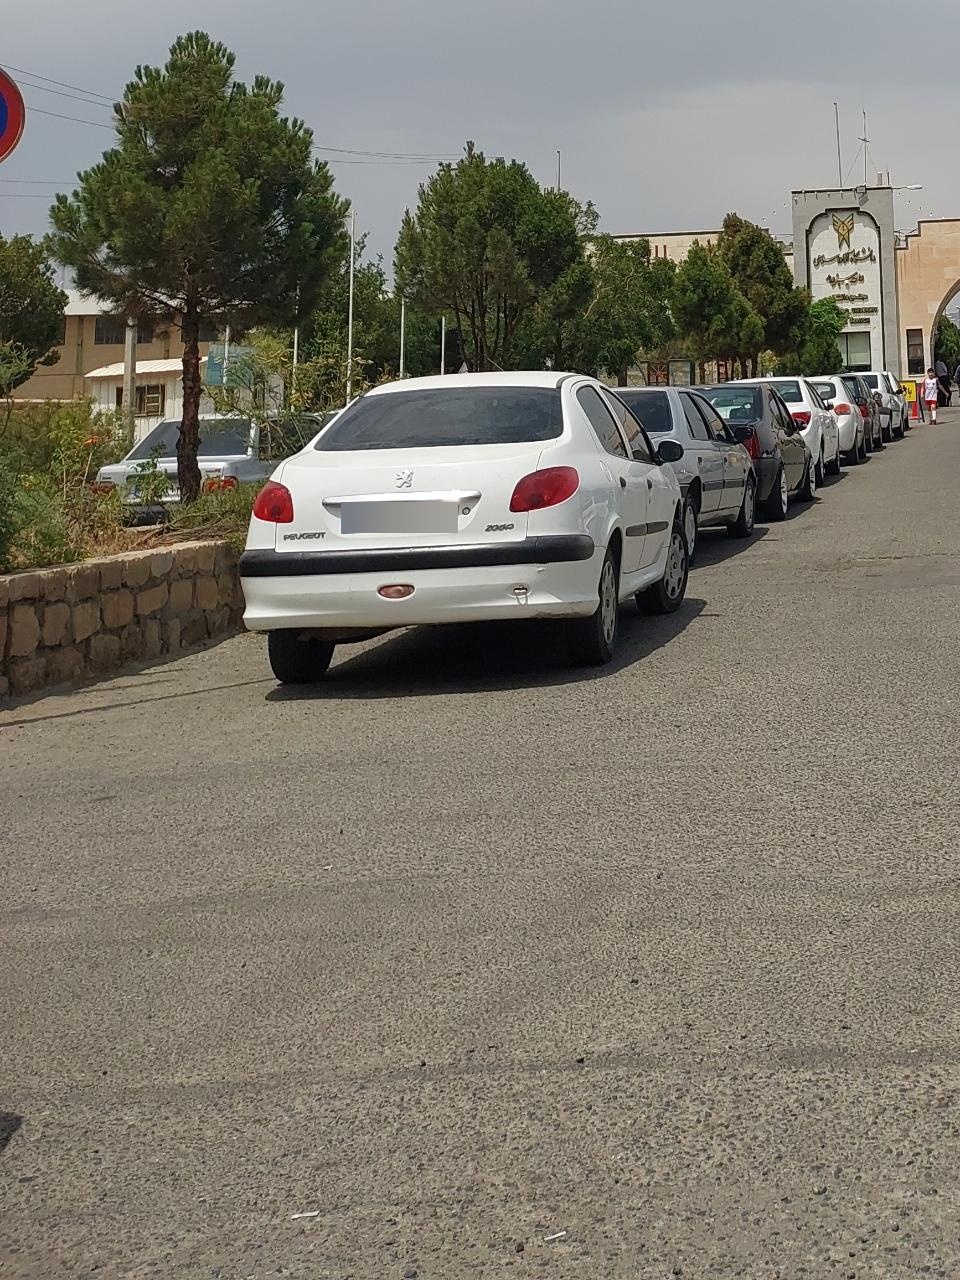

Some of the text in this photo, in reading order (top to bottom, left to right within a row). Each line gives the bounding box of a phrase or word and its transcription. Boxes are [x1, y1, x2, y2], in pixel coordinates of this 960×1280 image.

[813, 254, 839, 267] اسلامی
[850, 247, 876, 263] دانشگاه
[284, 532, 326, 541] PEUGEOT
